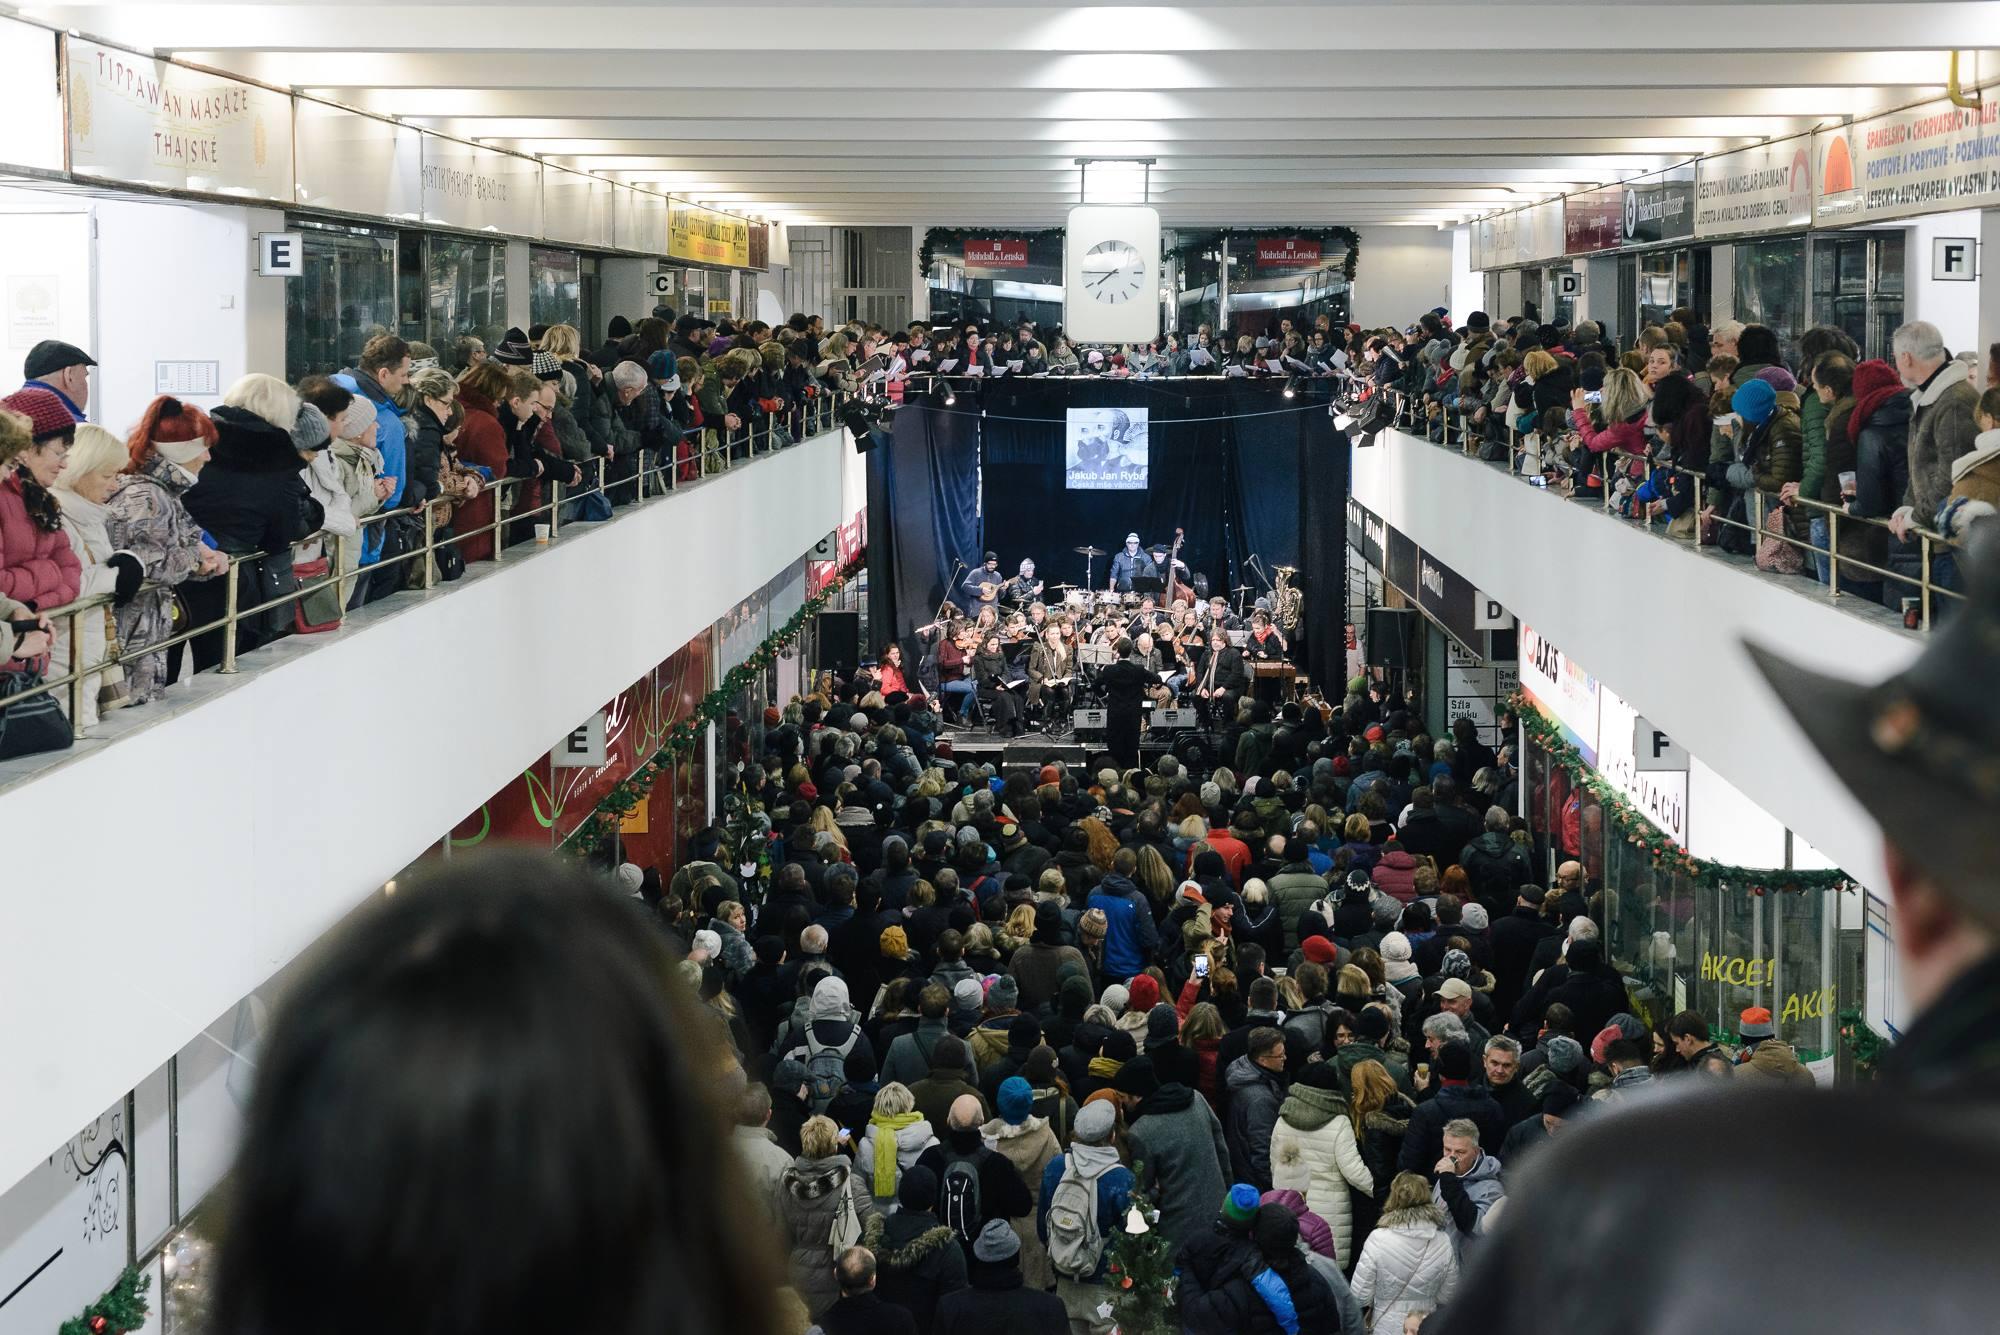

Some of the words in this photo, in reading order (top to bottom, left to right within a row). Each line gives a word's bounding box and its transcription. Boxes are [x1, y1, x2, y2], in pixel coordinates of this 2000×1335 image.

[97, 52, 182, 118] TIPPAWAN
[1913, 111, 1963, 141] CHORVATSKO
[1970, 101, 1998, 128] ITALIE
[1759, 166, 1789, 190] DIAMANT
[1900, 178, 1947, 205] AUTOKAREM
[1954, 165, 1988, 196] VLASTNÍ
[1772, 199, 1788, 216] CENU
[270, 240, 291, 268] E
[1944, 245, 1964, 272] F
[655, 275, 669, 293] C
[1563, 277, 1576, 292] D
[1069, 471, 1098, 480] Jakub
[1100, 471, 1117, 480] Jan
[1120, 471, 1145, 482] Ryba
[815, 538, 828, 554] C
[1487, 600, 1502, 620] D
[568, 726, 588, 753] E
[1653, 731, 1670, 758] F
[1701, 951, 1775, 987] AKCE!
